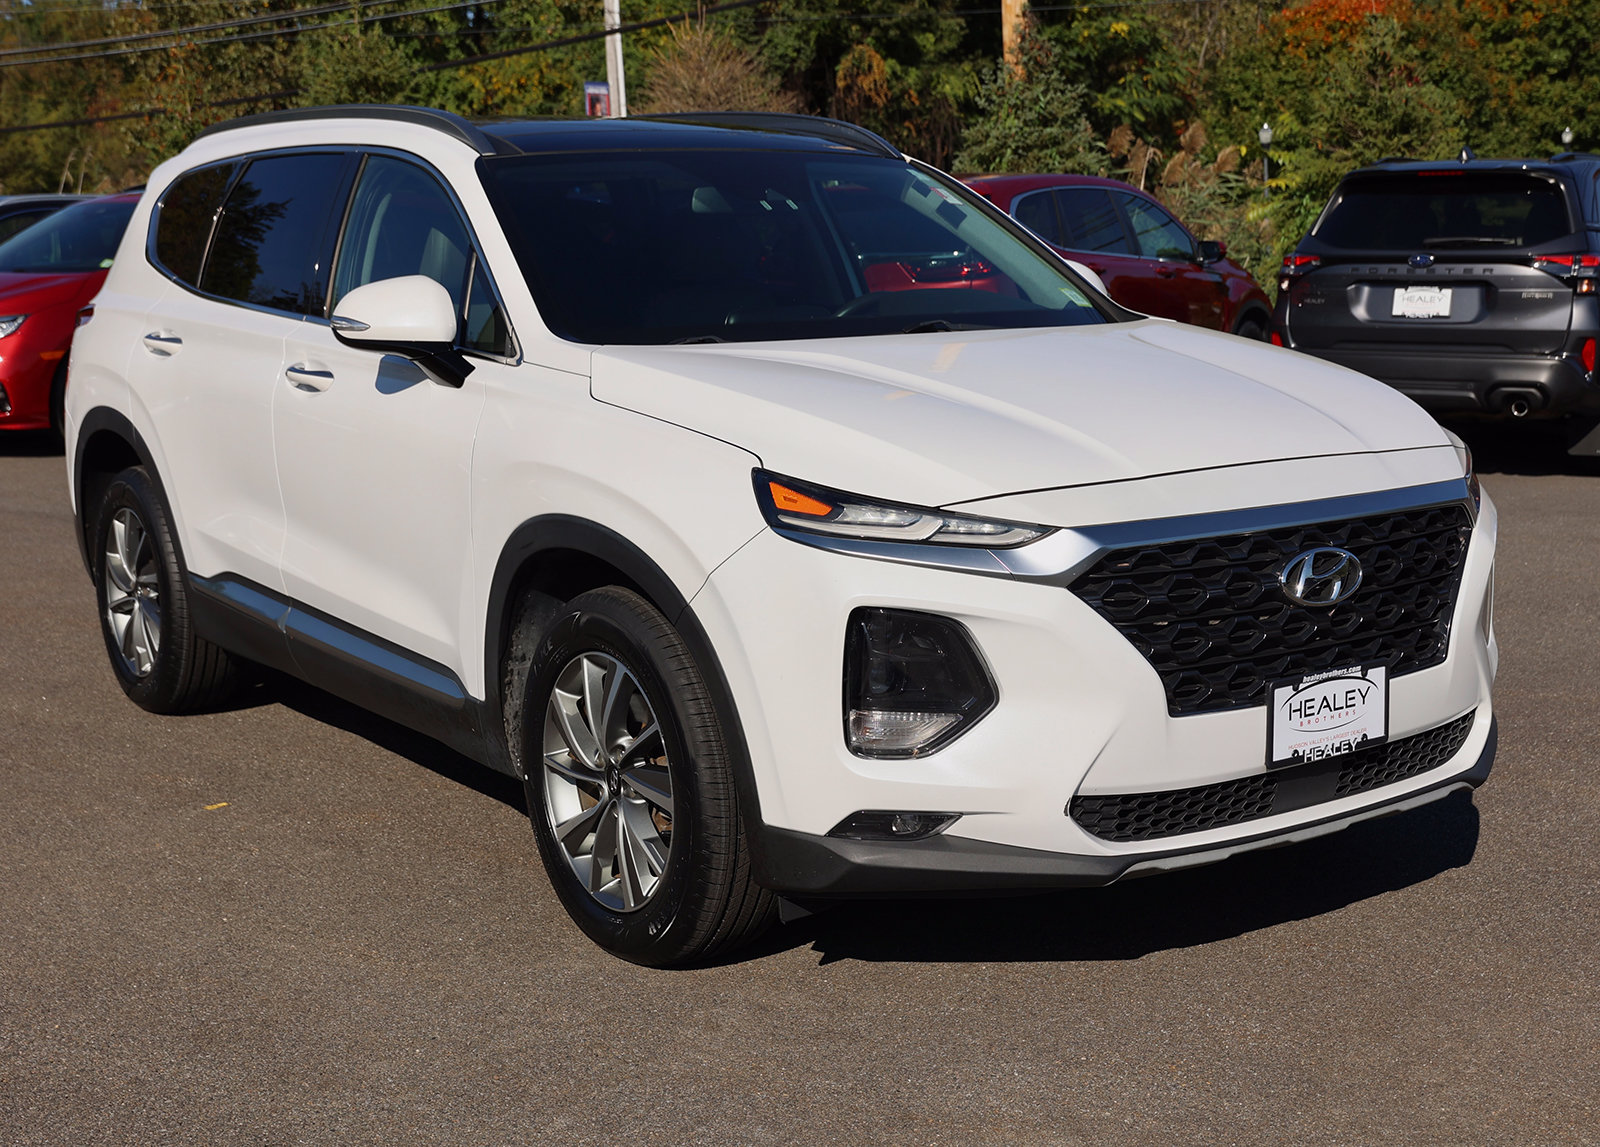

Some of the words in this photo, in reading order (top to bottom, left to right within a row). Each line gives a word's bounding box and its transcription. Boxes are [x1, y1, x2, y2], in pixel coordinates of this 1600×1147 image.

[1350, 267, 1494, 275] FORESTER
[1402, 295, 1443, 303] HEALEY
[1289, 686, 1371, 721] HEALEY
[1299, 710, 1356, 727] BROTHERS
[1288, 741, 1308, 750] HUDSON
[1304, 738, 1359, 763] HEALEY
